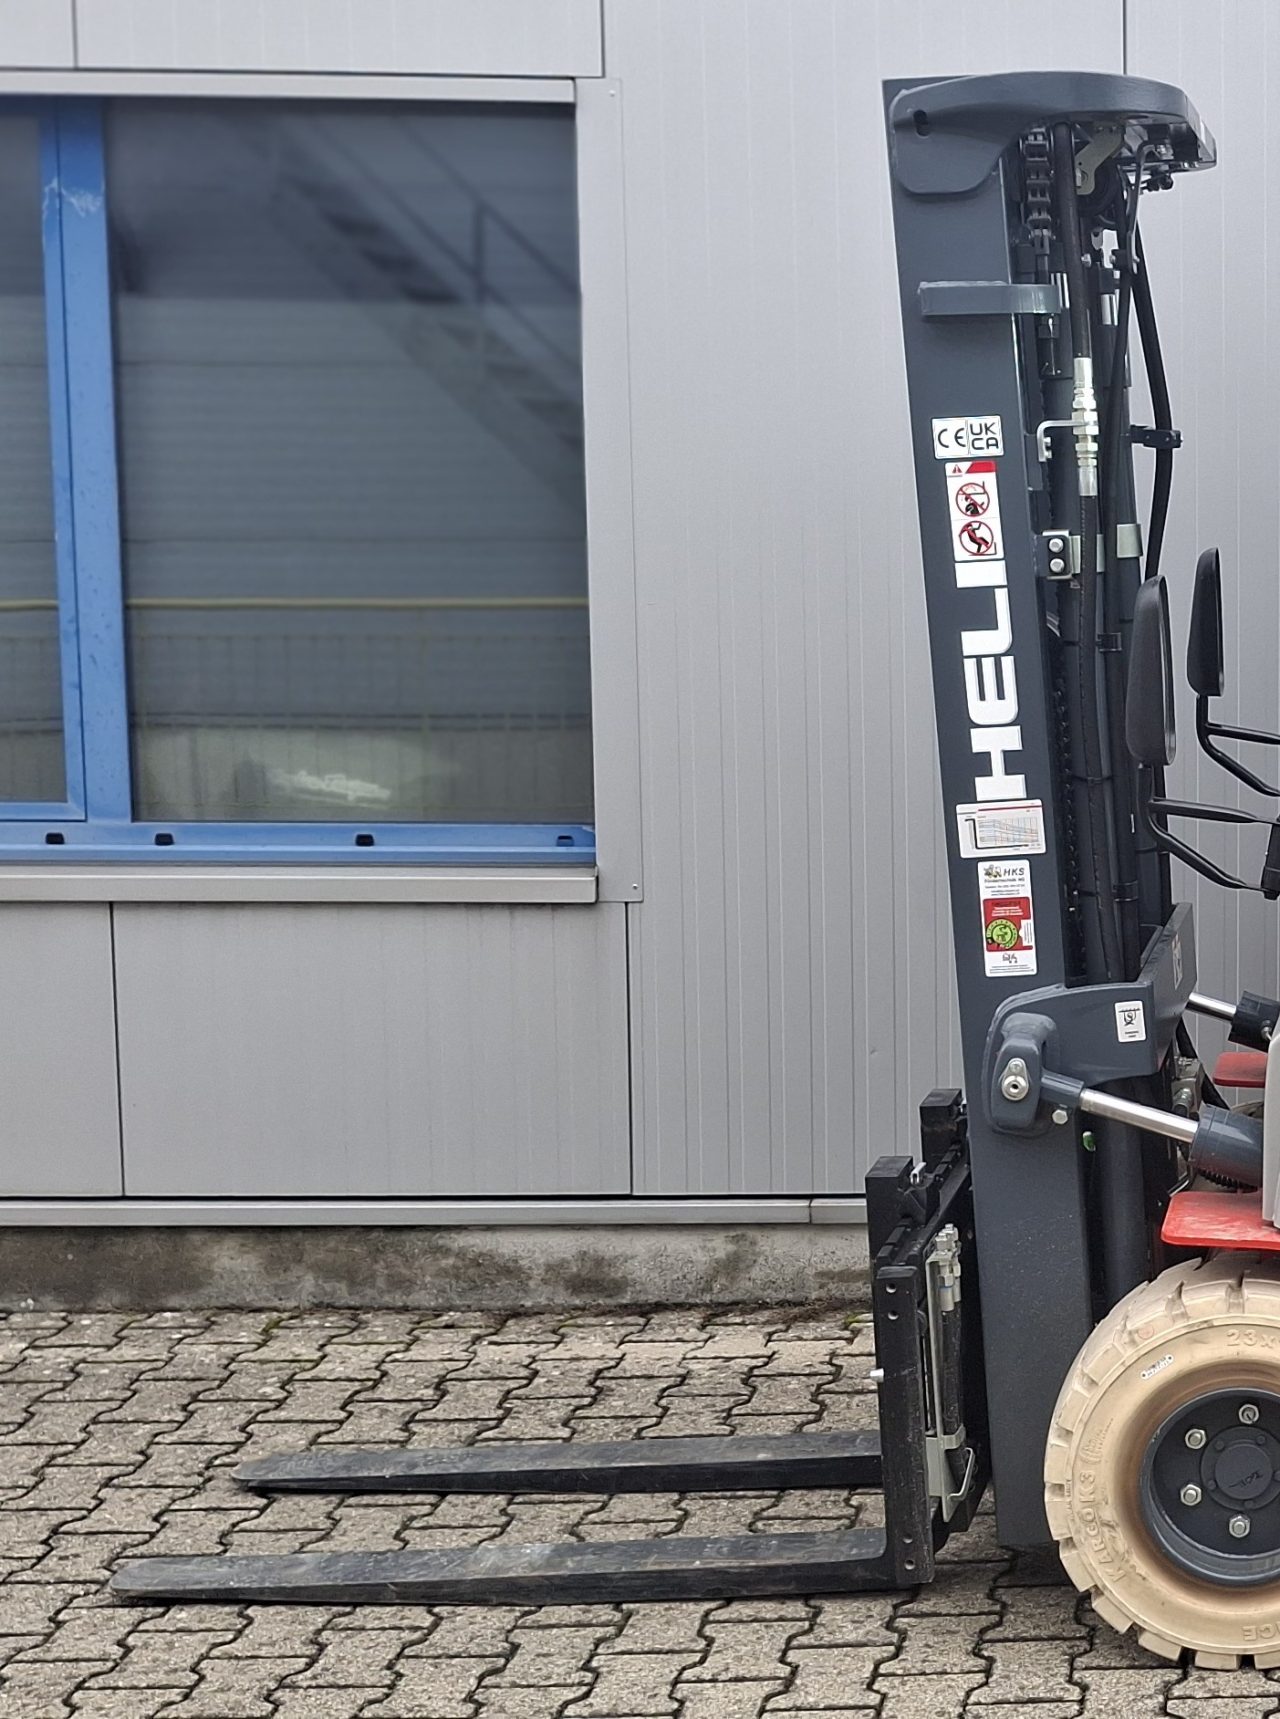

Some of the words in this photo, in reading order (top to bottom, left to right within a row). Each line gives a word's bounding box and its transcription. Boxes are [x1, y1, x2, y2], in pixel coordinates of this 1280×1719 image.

[970, 422, 996, 436] UK
[937, 427, 967, 448] CE
[971, 437, 999, 450] CA
[954, 559, 1027, 802] HELI
[1003, 867, 1025, 877] HKS
